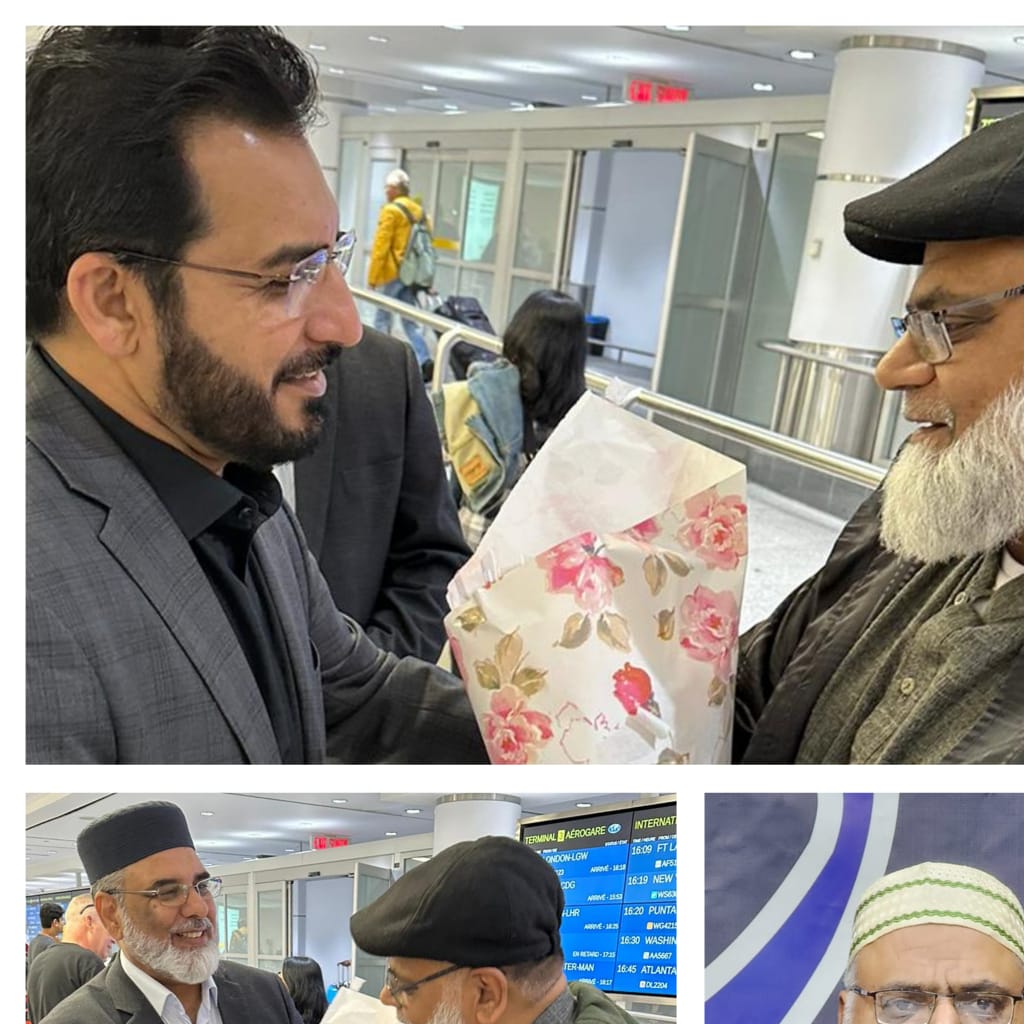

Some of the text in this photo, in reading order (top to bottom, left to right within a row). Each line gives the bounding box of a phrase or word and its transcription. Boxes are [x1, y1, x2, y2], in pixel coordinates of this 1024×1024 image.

[525, 825, 606, 845] TERMINAL AÉROGARE
[631, 843, 668, 856] 16:09 FT
[628, 873, 672, 886] 16:19 NEW
[623, 905, 677, 916] 16:20 PUNTA
[620, 936, 641, 945] 16:30
[616, 964, 677, 976] 16:45 ATLANTA
